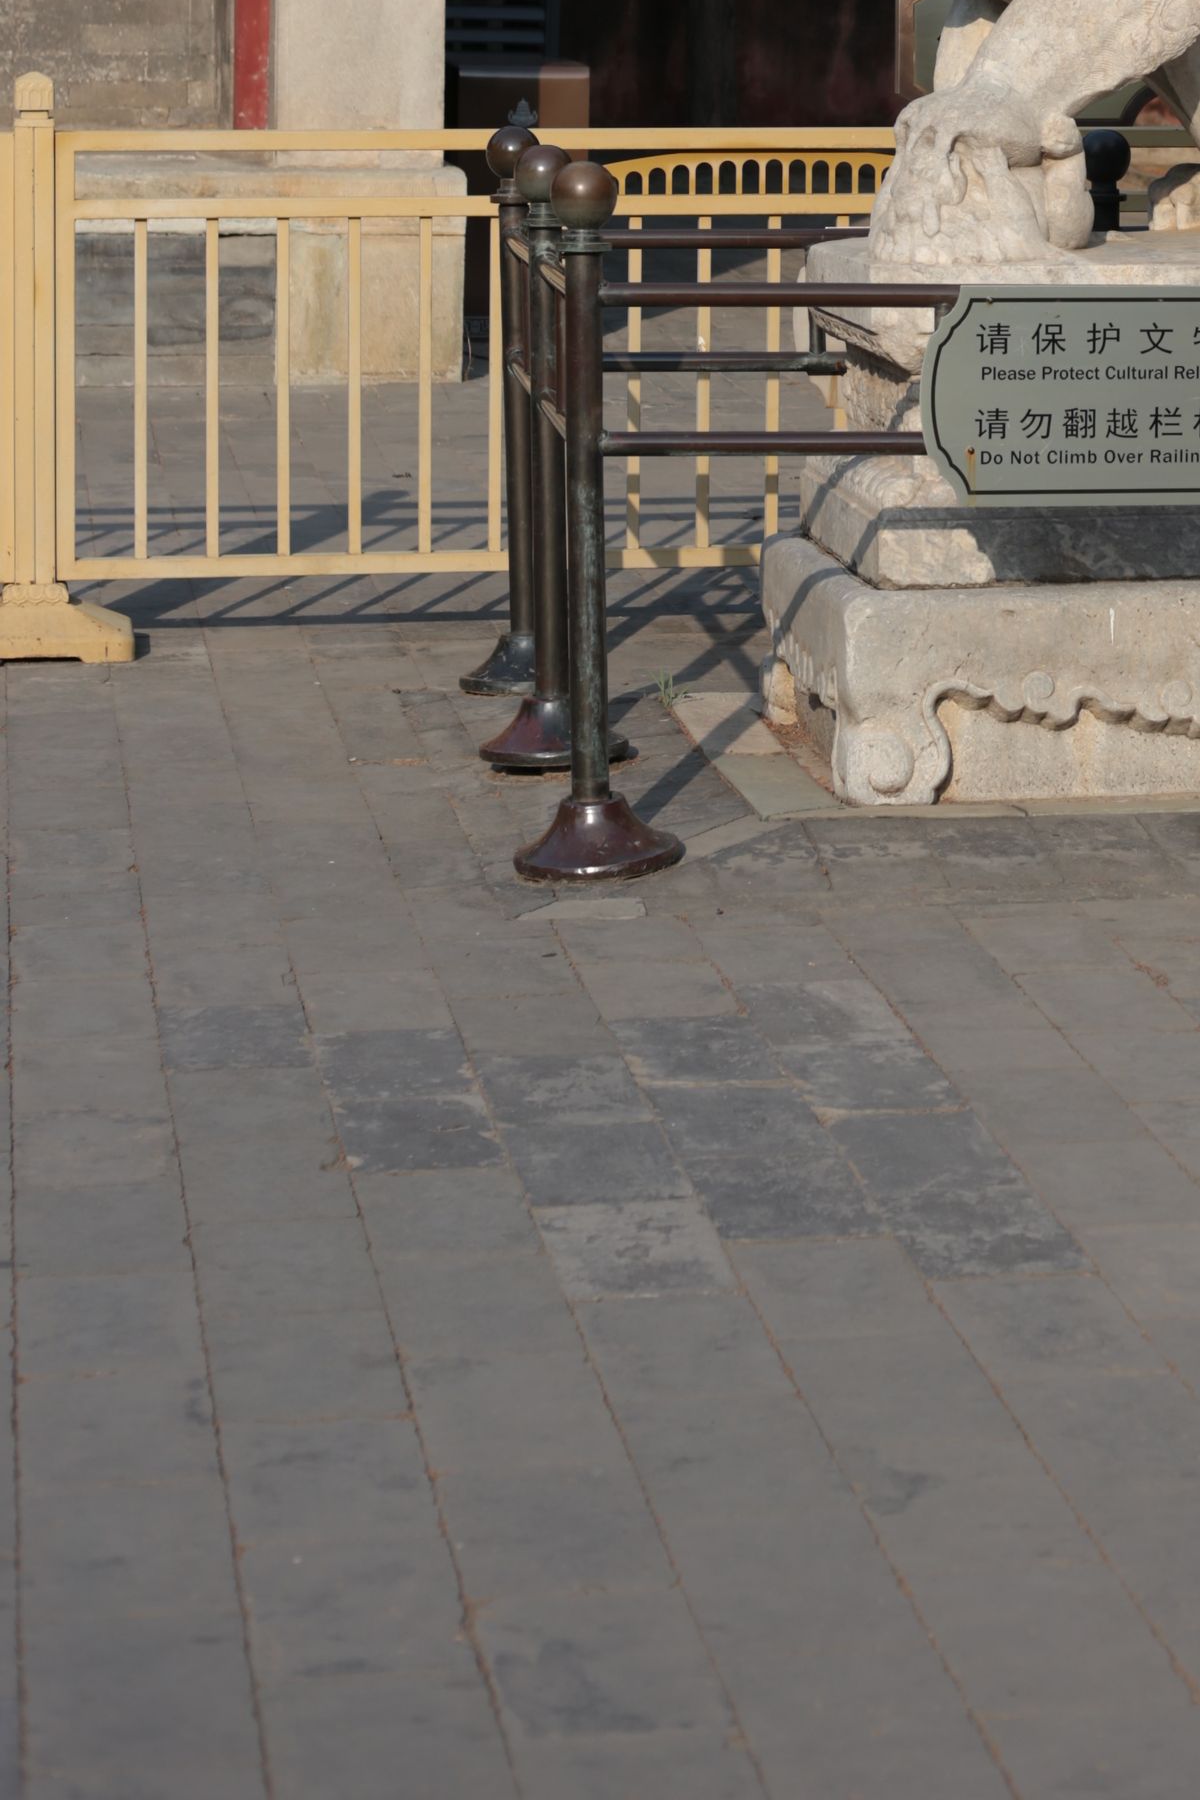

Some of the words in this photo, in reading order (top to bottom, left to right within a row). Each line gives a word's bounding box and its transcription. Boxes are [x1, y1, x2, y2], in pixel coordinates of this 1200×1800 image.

[981, 366, 1036, 381] Please
[1041, 365, 1100, 381] Protect
[1105, 365, 1168, 380] Cultural
[980, 450, 1004, 465] Do
[1010, 450, 1040, 465] Not
[1047, 449, 1097, 465] Climb
[1104, 449, 1144, 464] Over
